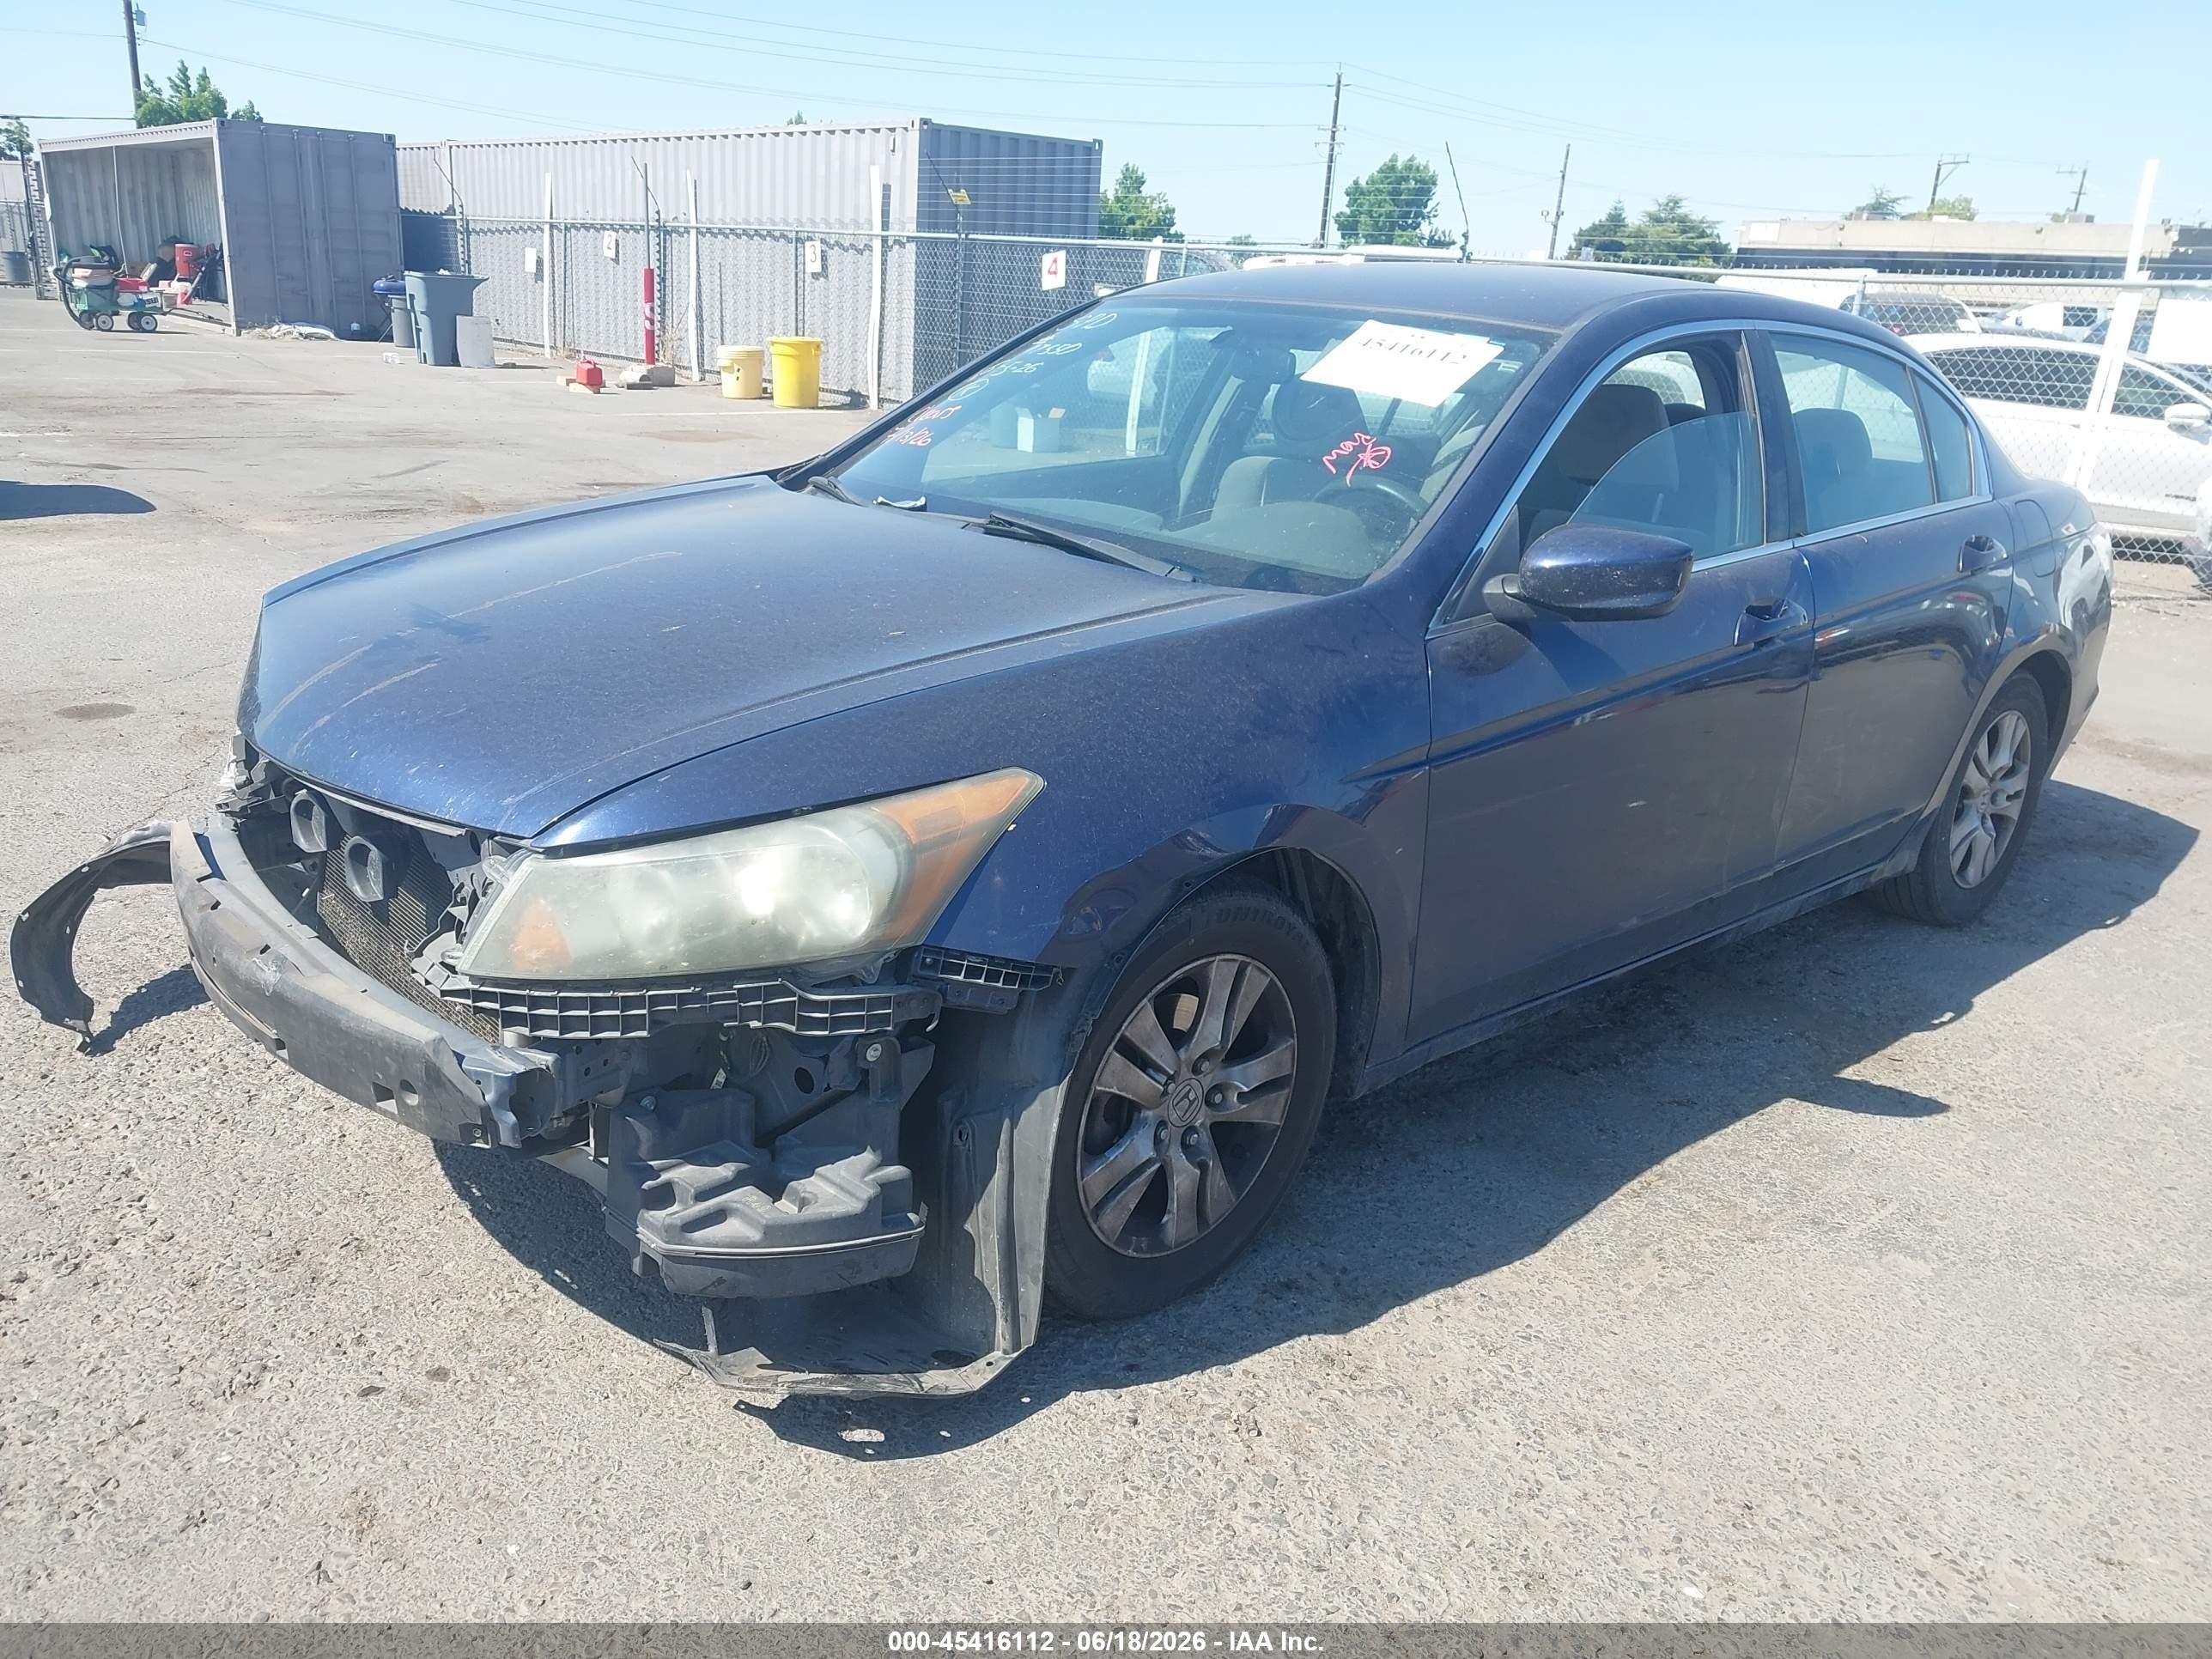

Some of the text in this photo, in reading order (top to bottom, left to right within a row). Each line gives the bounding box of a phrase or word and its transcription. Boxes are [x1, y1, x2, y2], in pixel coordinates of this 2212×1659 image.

[606, 234, 612, 250] 2
[810, 244, 817, 263] 3
[1047, 256, 1059, 279] 4
